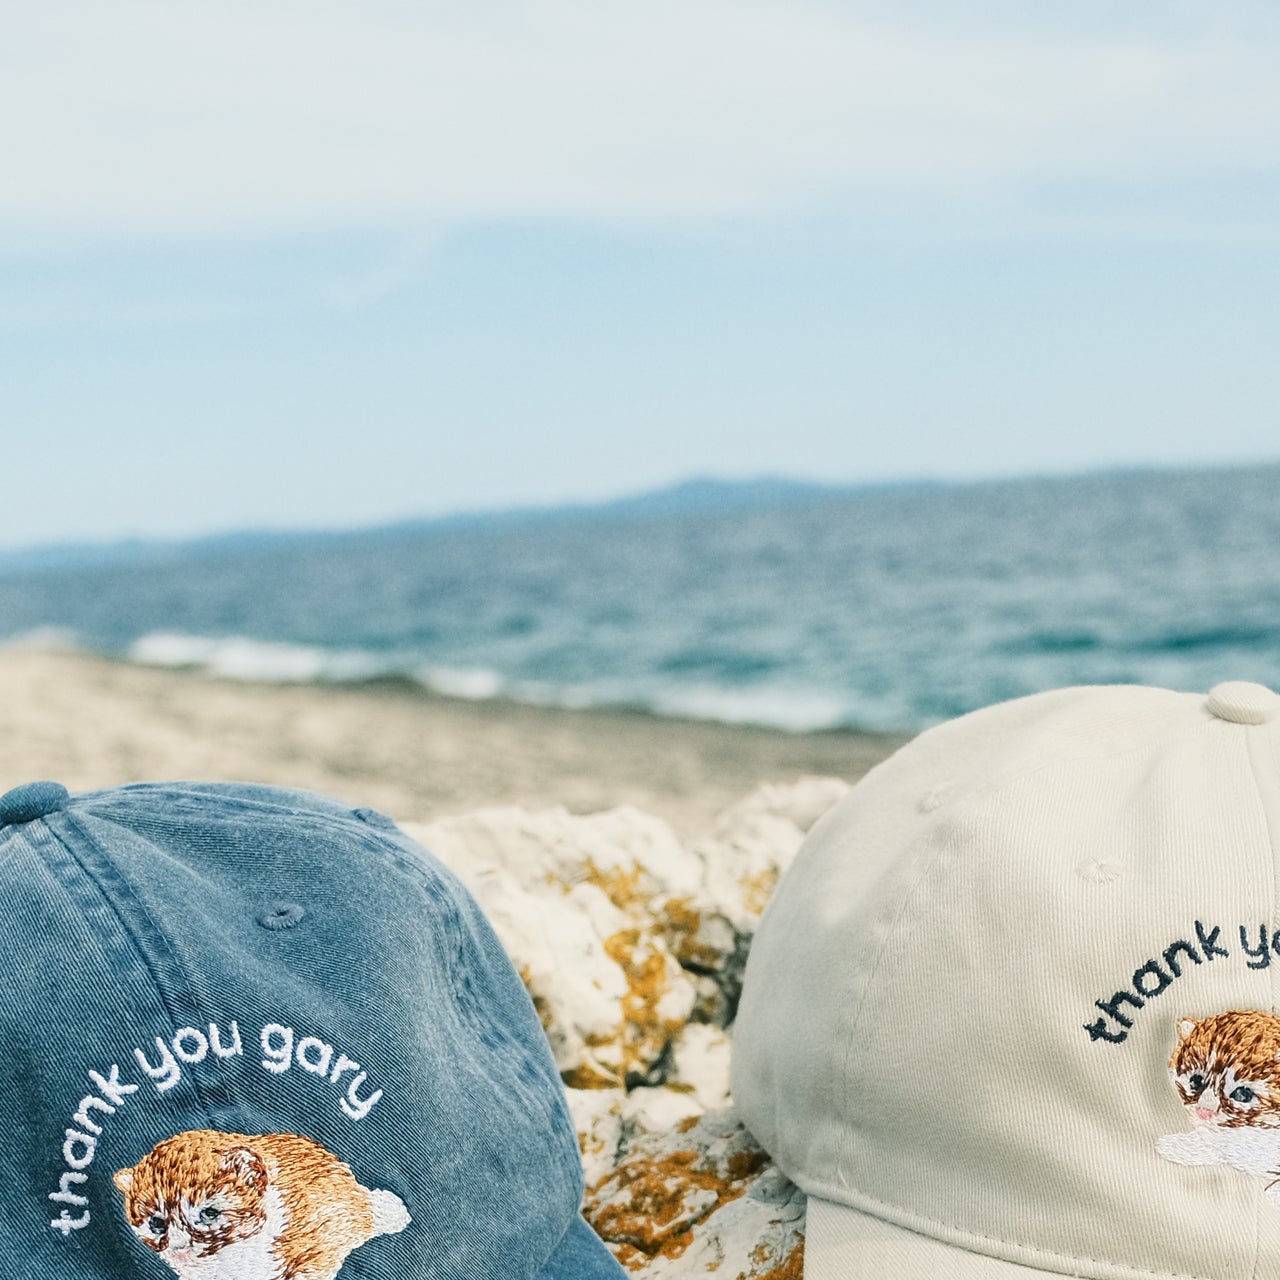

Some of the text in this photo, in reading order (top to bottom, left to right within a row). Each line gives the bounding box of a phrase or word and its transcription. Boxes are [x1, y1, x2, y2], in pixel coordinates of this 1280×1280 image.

[1082, 920, 1229, 1044] thank
[48, 1020, 384, 1236] thank you gary
